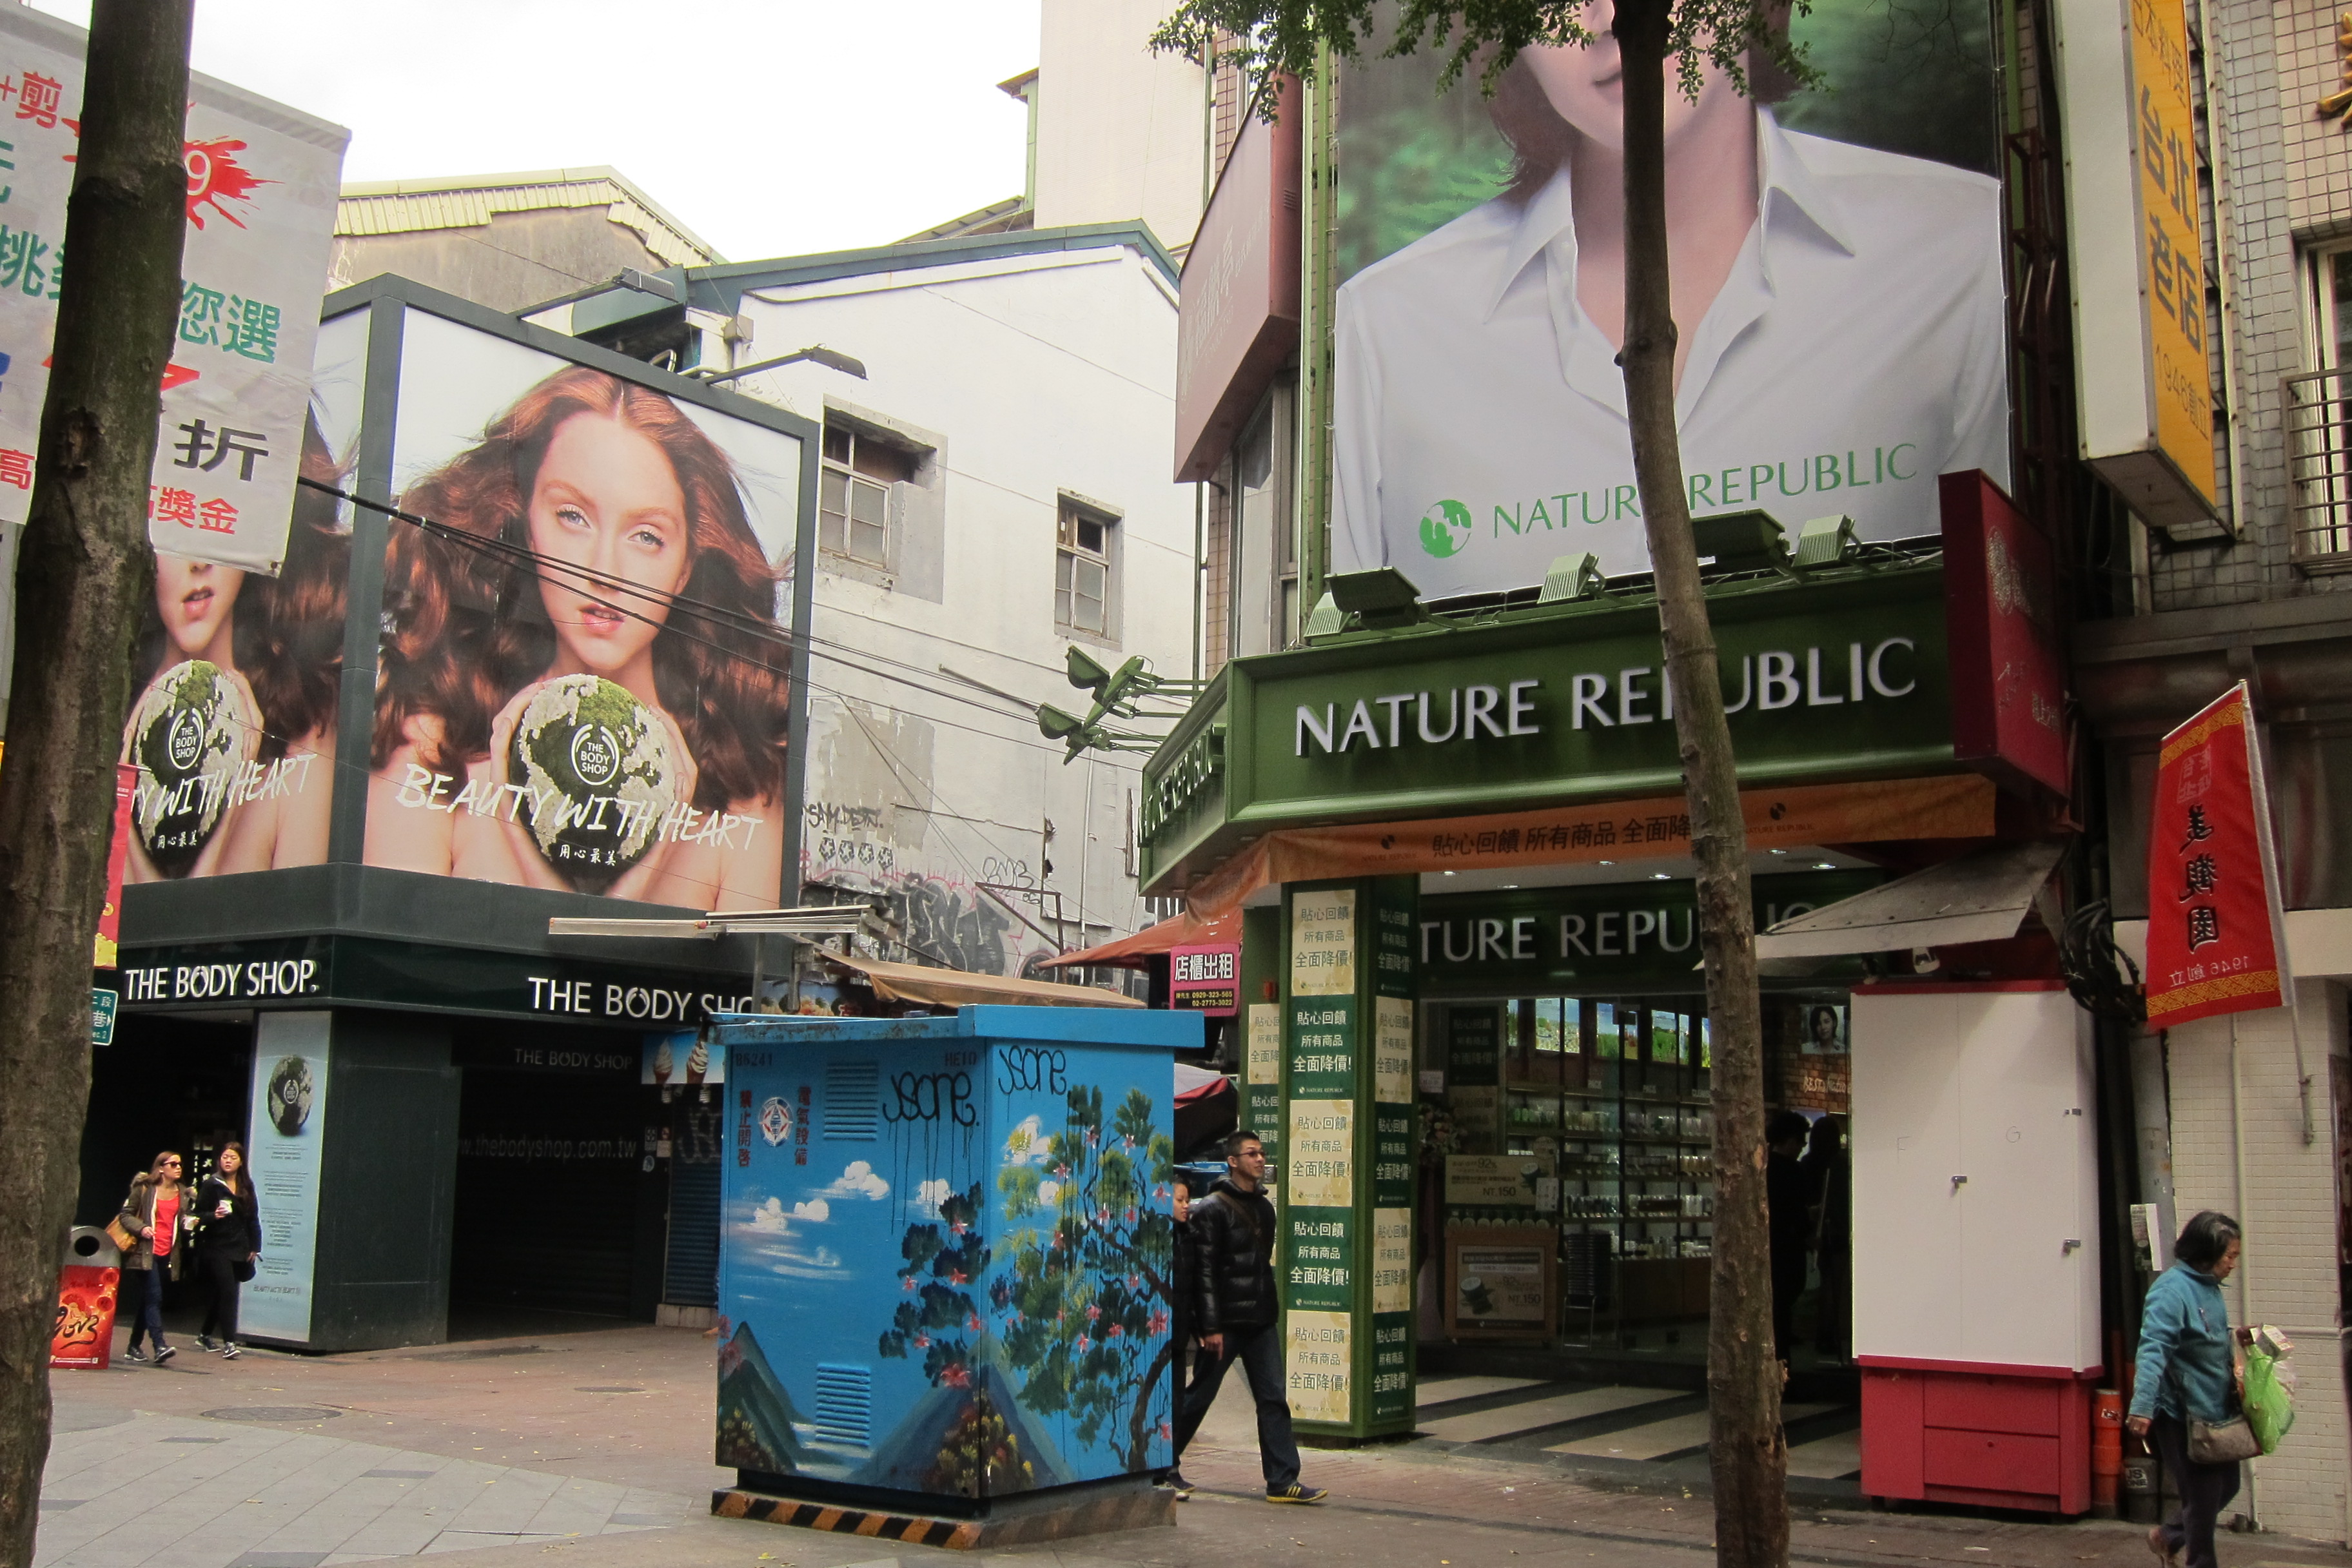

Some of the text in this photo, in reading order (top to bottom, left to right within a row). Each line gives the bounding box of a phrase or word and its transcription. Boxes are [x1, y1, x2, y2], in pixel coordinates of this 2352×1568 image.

[2149, 213, 2202, 355] 老店
[174, 418, 270, 482] 折
[1689, 442, 1917, 511] REPUBLIC
[1295, 679, 1541, 758] NATURE
[181, 726, 194, 736] THE
[175, 736, 197, 748] BODY
[587, 741, 604, 754] THE
[175, 747, 196, 760] SHOP
[580, 751, 611, 765] BODY
[581, 761, 609, 776] SHOP
[153, 765, 231, 819] WITH
[227, 753, 318, 809] HEART
[396, 763, 765, 850] BEAUTY WITH HEART
[1432, 828, 1520, 858] 貼心回饋
[1524, 819, 1616, 852] 所有商品
[559, 844, 617, 867] 用心最美
[1300, 906, 1350, 922] 貼心回饋
[1303, 930, 1345, 944] 所有商品
[1174, 953, 1233, 981] 店櫃出租
[1295, 950, 1354, 969] 全面降價!
[126, 968, 167, 1000] THE
[175, 964, 242, 998] BODY
[528, 977, 591, 1014] THE
[605, 985, 692, 1021] BODY
[1297, 1010, 1347, 1026] 貼心回饋
[1300, 1034, 1343, 1048] 所有商品
[514, 1048, 633, 1070] THE BODY SHOP
[1293, 1054, 1352, 1073] 全面降價!
[1297, 1116, 1348, 1131] 貼心回饋
[1300, 1140, 1342, 1153] 所有商品
[1292, 1161, 1350, 1179] 全面降價!
[1294, 1221, 1344, 1239] 貼心回饋
[1298, 1246, 1341, 1260] 所有商品
[1290, 1266, 1349, 1286] 全面降價!
[1295, 1327, 1345, 1344] 貼心回饋
[1298, 1351, 1341, 1366] 所有商品
[1289, 1372, 1349, 1393] 全面降價!
